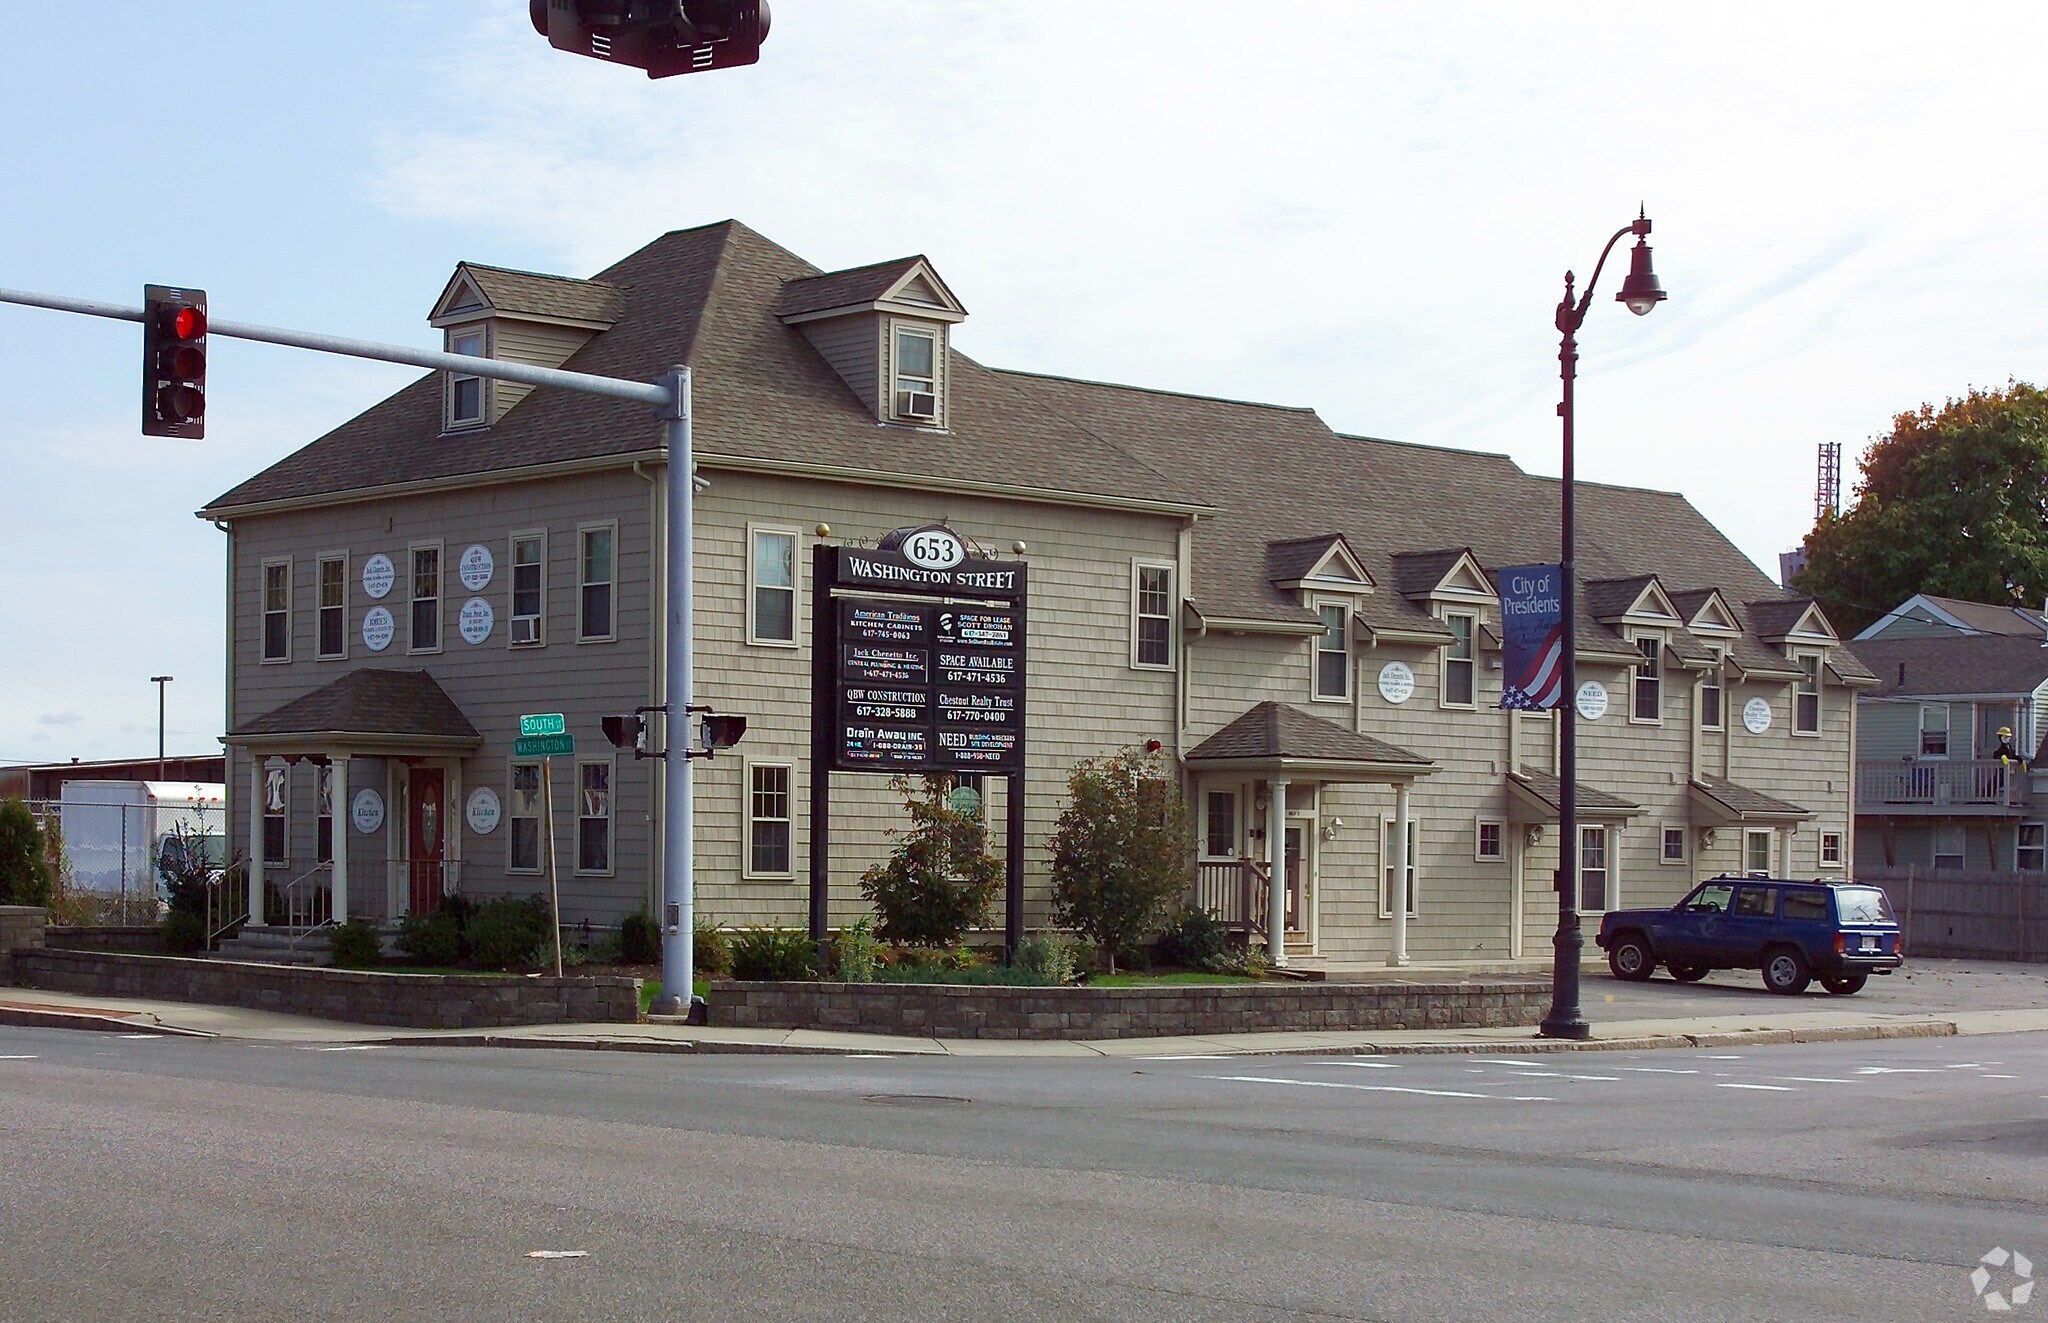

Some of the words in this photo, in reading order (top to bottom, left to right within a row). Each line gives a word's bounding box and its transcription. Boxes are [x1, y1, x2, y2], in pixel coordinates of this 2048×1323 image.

[913, 537, 954, 561] 653
[849, 556, 951, 585] WASHINGTON
[956, 571, 1015, 590] STREET
[1511, 576, 1534, 599] City
[1537, 574, 1550, 593] of
[1503, 596, 1560, 615] Presidents
[854, 609, 886, 618] American
[887, 611, 920, 621] Traditions
[960, 614, 978, 622] SPACE
[850, 620, 884, 628] KITCHEN
[886, 623, 923, 631] CABINETS
[957, 621, 982, 629] SCOTT
[983, 623, 1013, 631] DROHAN
[853, 647, 869, 657] Jack
[939, 654, 967, 667] SPACE
[968, 656, 1014, 669] AVAILABLE
[947, 670, 1006, 684] 617-471-4536
[867, 690, 926, 703] CONSTRUCTION
[939, 693, 969, 705] Chestnut
[971, 694, 993, 709] Realty
[994, 696, 1013, 708] Trust
[856, 705, 917, 719] 617-328-5888
[947, 709, 1006, 722] 617-770-0400
[523, 718, 554, 731] SOUTH
[555, 719, 562, 729] ST
[846, 727, 875, 739] Drain
[877, 728, 907, 741] Away
[907, 732, 925, 741] INC.
[939, 732, 967, 747] NEED
[516, 739, 565, 753] WASHINGTON
[357, 808, 379, 817] Kitchen
[471, 807, 495, 817] Kitchen
